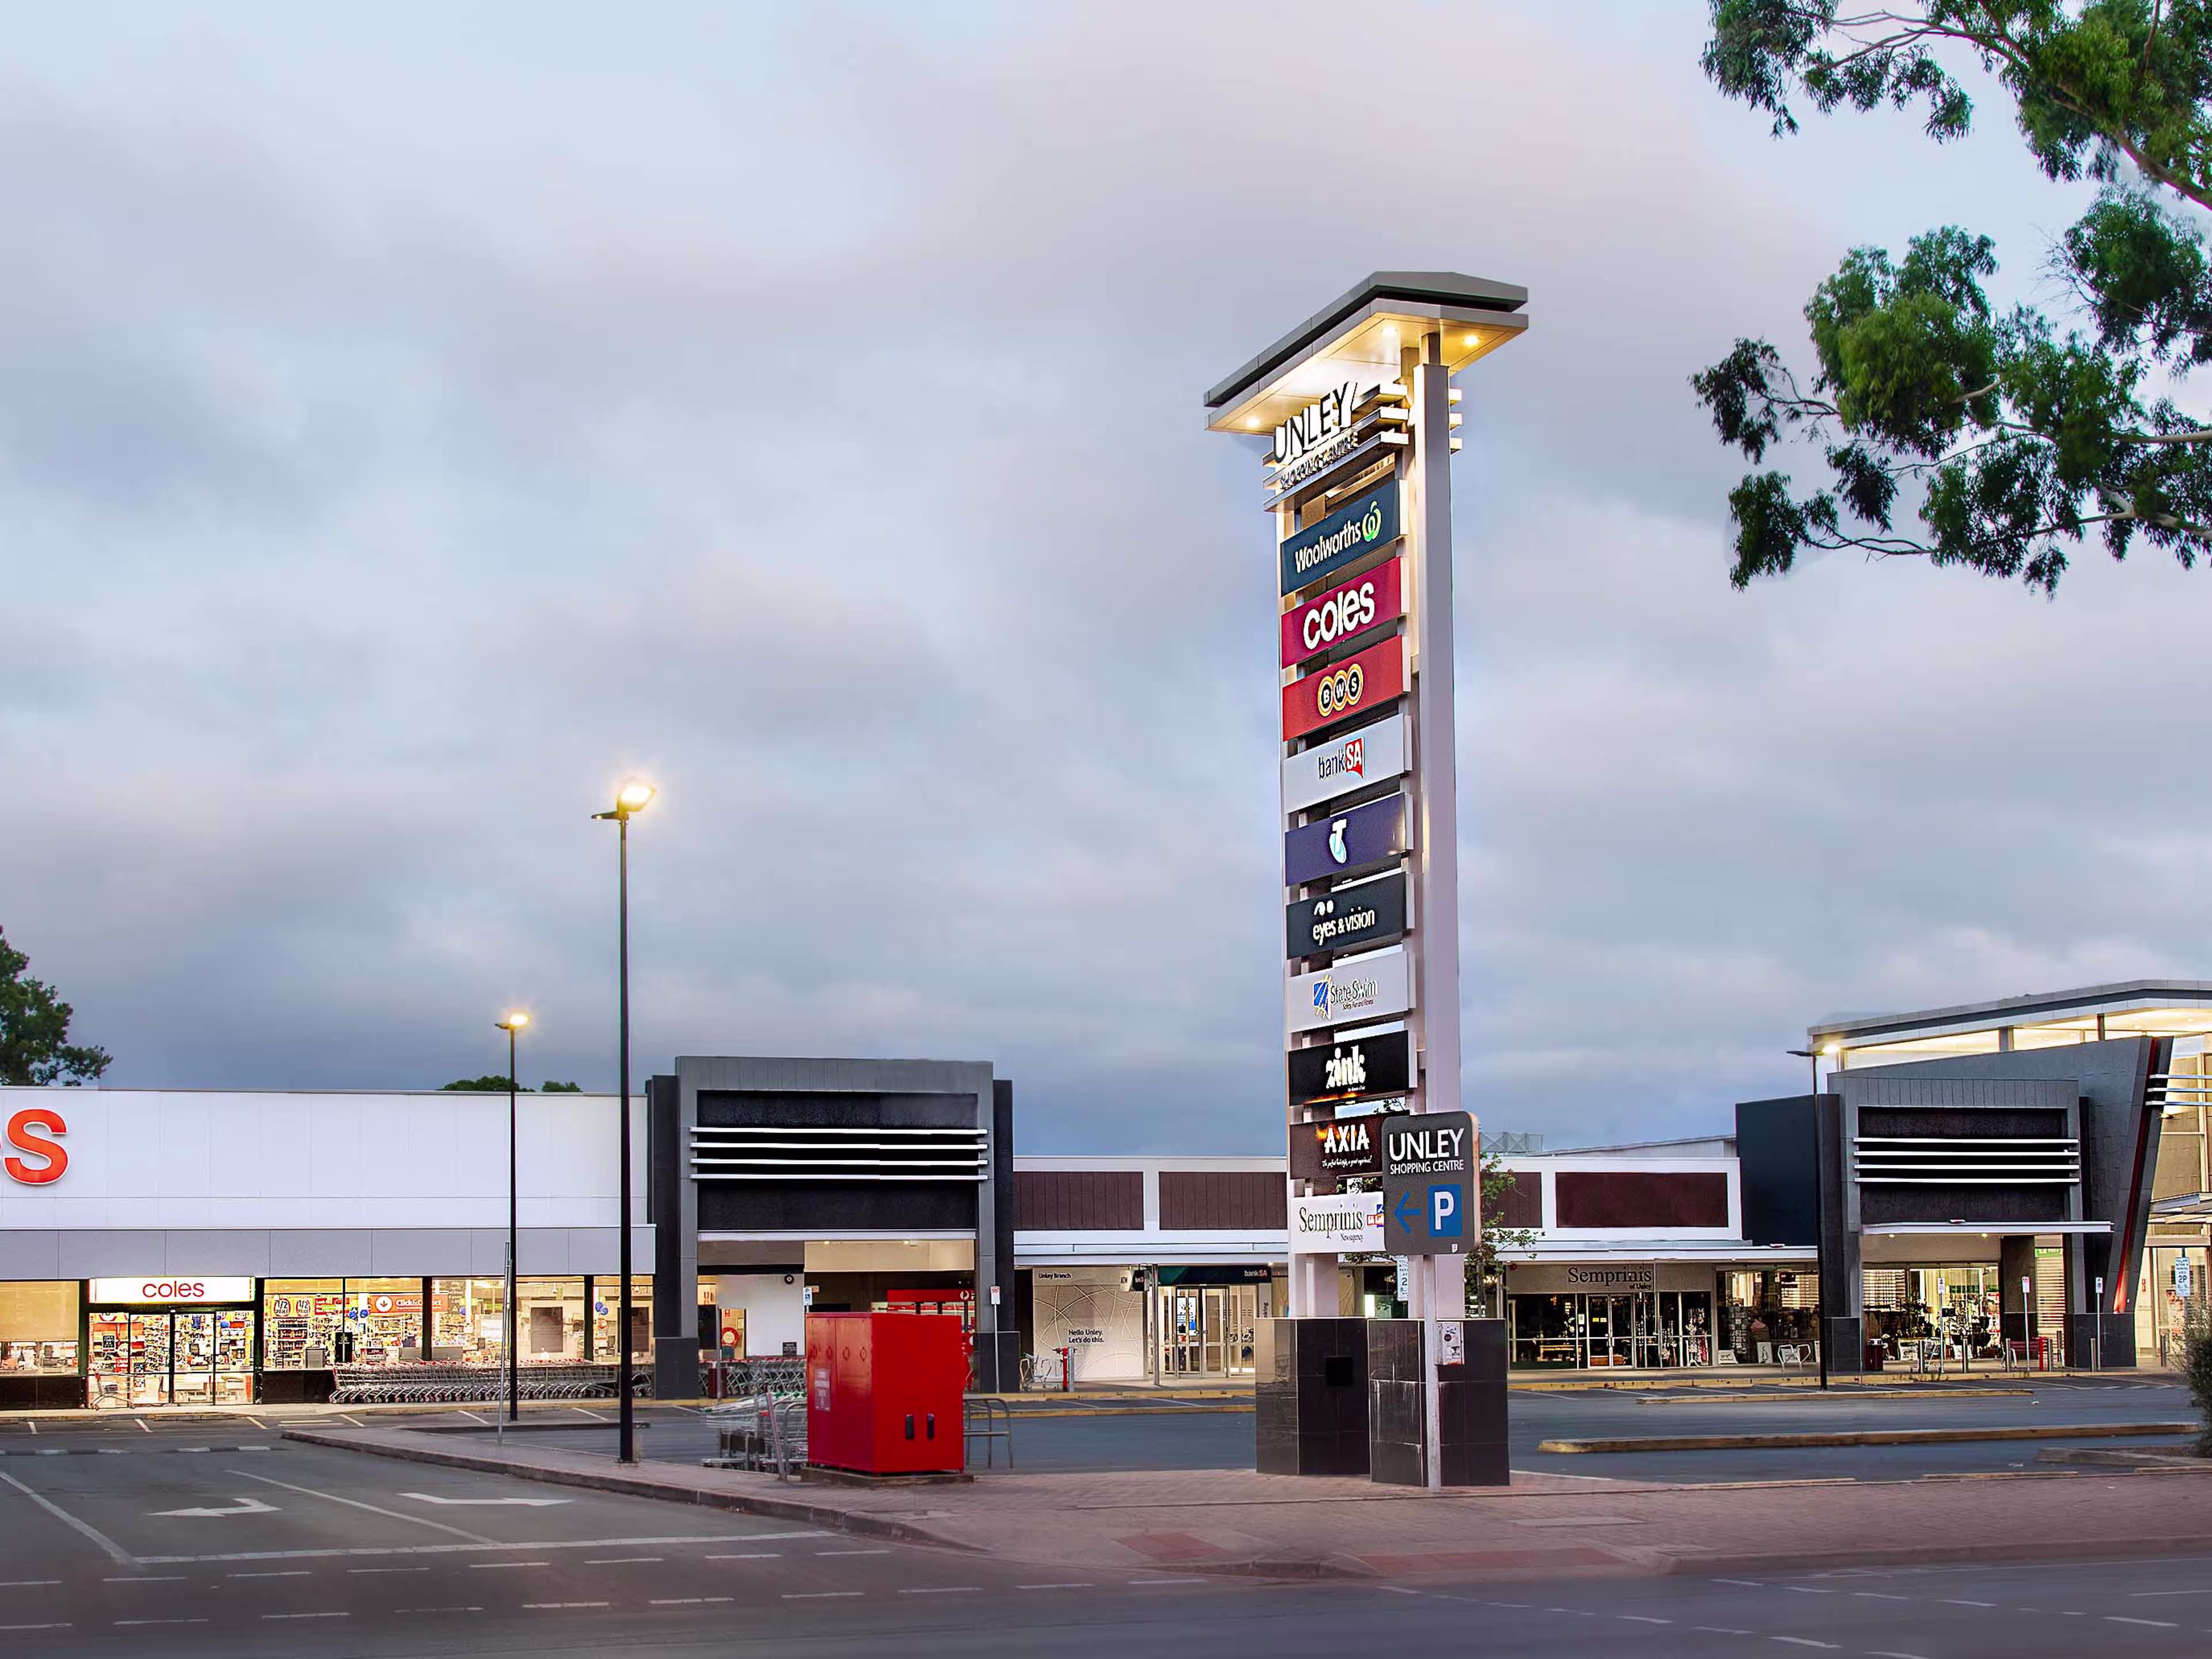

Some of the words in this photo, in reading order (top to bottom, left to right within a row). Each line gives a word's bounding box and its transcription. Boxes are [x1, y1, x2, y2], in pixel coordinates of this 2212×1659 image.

[1274, 381, 1358, 463] UNLEY
[1295, 520, 1361, 573] Woolworths
[1303, 582, 1375, 650] coles
[1318, 741, 1363, 779] bankSA
[1312, 919, 1336, 946] eyes
[1338, 918, 1345, 934] &
[1345, 906, 1375, 931] vision
[1326, 1045, 1366, 1089] zink
[1324, 1123, 1370, 1154] AXIA
[1389, 1128, 1464, 1161] UNLEY
[1390, 1162, 1431, 1175] SHOPPING
[1433, 1159, 1464, 1172] CENTRE
[1299, 1203, 1364, 1240] Semprinis
[1434, 1191, 1455, 1230] P
[142, 1281, 204, 1298] coles
[1402, 1277, 1408, 1286] 2
[1568, 1266, 1652, 1287] Semprinis
[2178, 1275, 2187, 1283] 2P
[1085, 1330, 1104, 1338] Unley.
